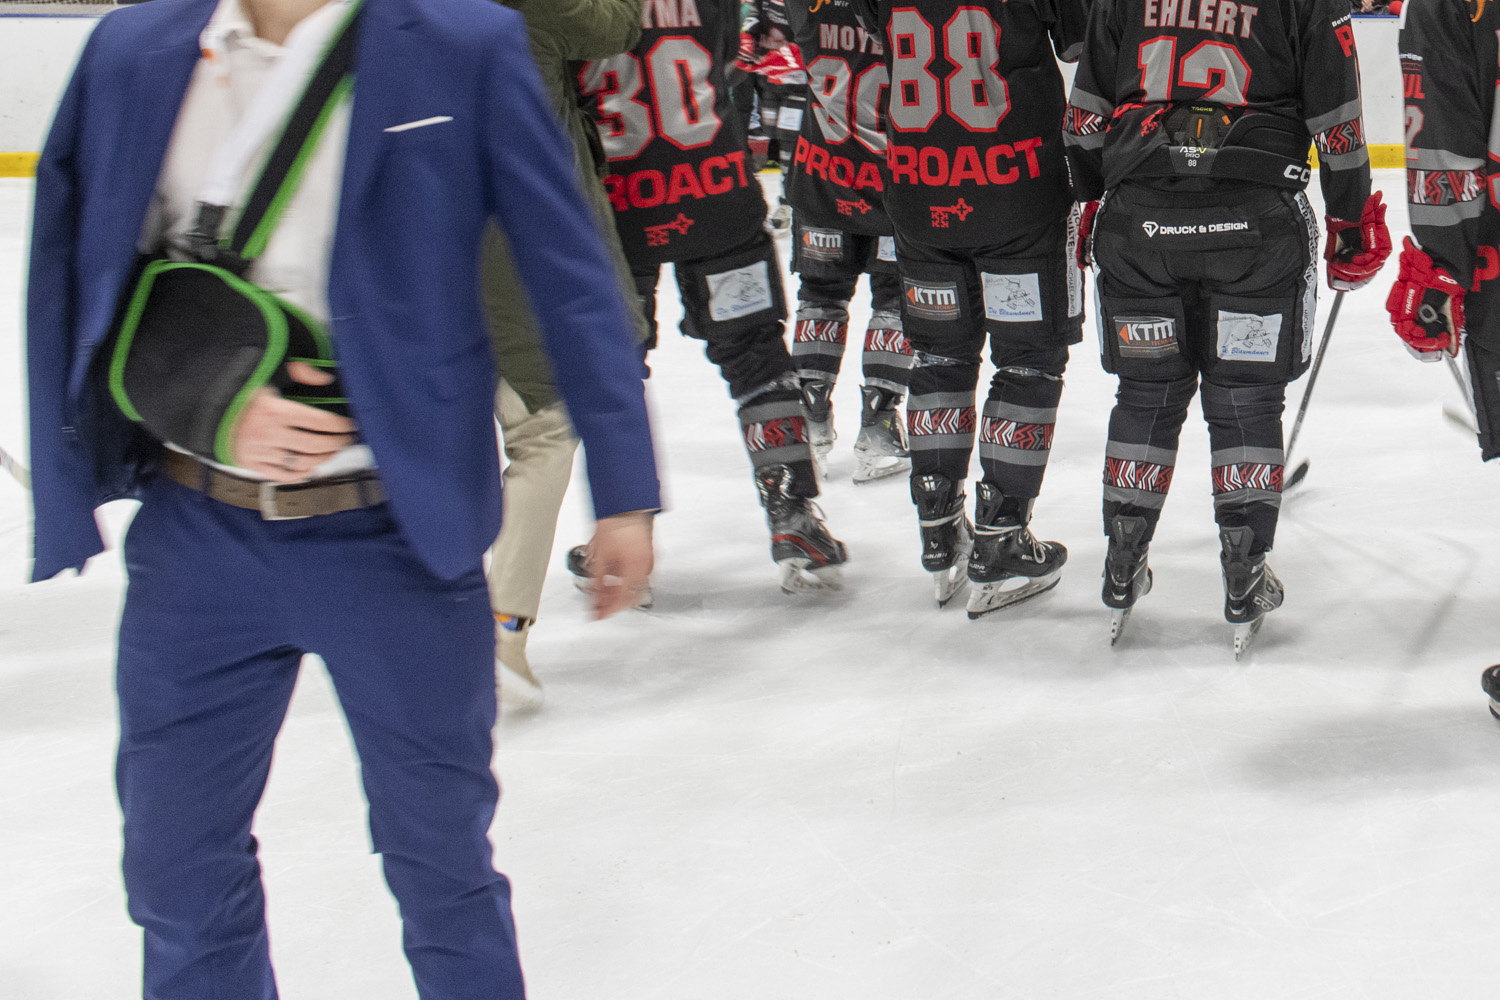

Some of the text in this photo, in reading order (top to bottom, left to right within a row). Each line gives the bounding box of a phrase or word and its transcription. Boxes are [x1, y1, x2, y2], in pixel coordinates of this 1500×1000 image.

[886, 5, 1012, 133] 88
[1137, 36, 1252, 106] 12
[577, 35, 723, 162] 30
[1159, 221, 1249, 235] DRUCK & DESIGN
[809, 231, 841, 248] KTM
[914, 286, 956, 305] KTM
[1126, 322, 1175, 341] KTM
